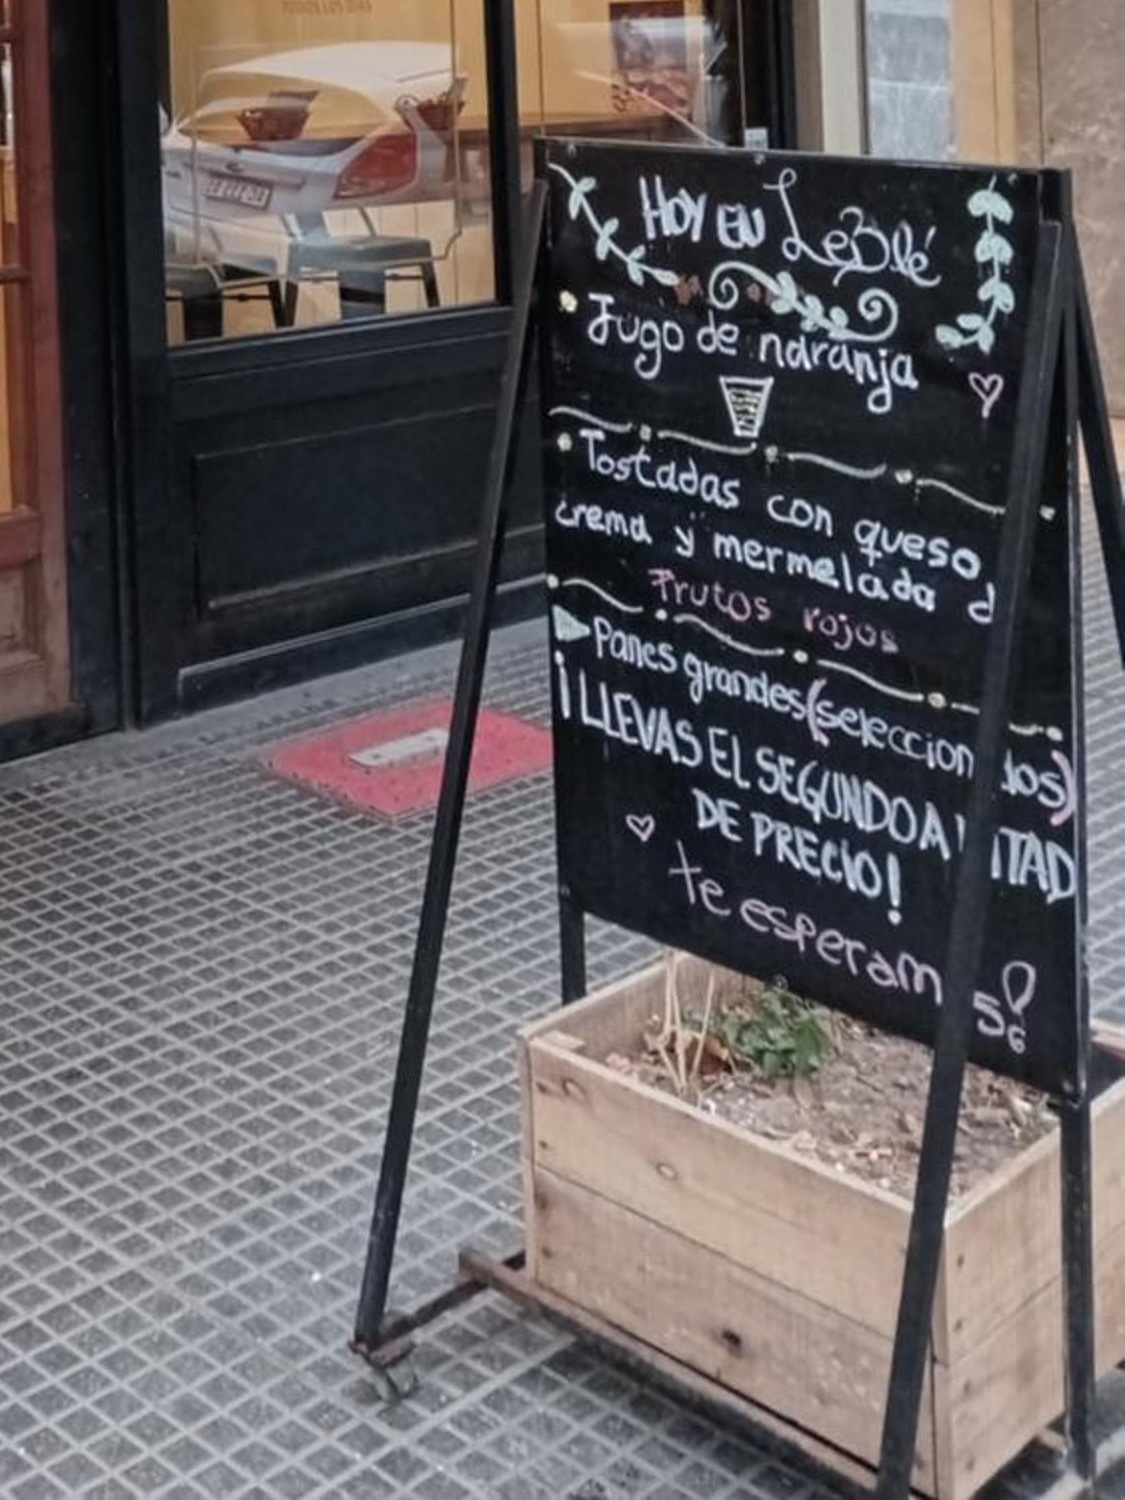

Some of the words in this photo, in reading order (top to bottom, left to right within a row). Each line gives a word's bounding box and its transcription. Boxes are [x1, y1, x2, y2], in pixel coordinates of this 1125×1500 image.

[588, 292, 685, 380] Jugo
[696, 308, 740, 357] de
[759, 332, 920, 414] naranja
[555, 499, 653, 545] crema
[674, 524, 695, 559] y
[713, 530, 937, 613] mermelada
[579, 428, 740, 509] Tostadas
[767, 494, 833, 538] con
[854, 519, 982, 580] queso
[648, 567, 771, 622] Frutos
[803, 605, 899, 653] rojos
[593, 615, 677, 674] Panes
[683, 652, 807, 720] grandes
[806, 678, 1077, 826] (seleccionos)
[692, 788, 742, 842] DE
[750, 812, 903, 926] PRECIO!
[707, 726, 751, 789] EL
[755, 747, 917, 844] SEGUNDO
[955, 813, 1077, 904] ITAD
[668, 839, 732, 916] te
[739, 898, 1037, 1054] esperams!
